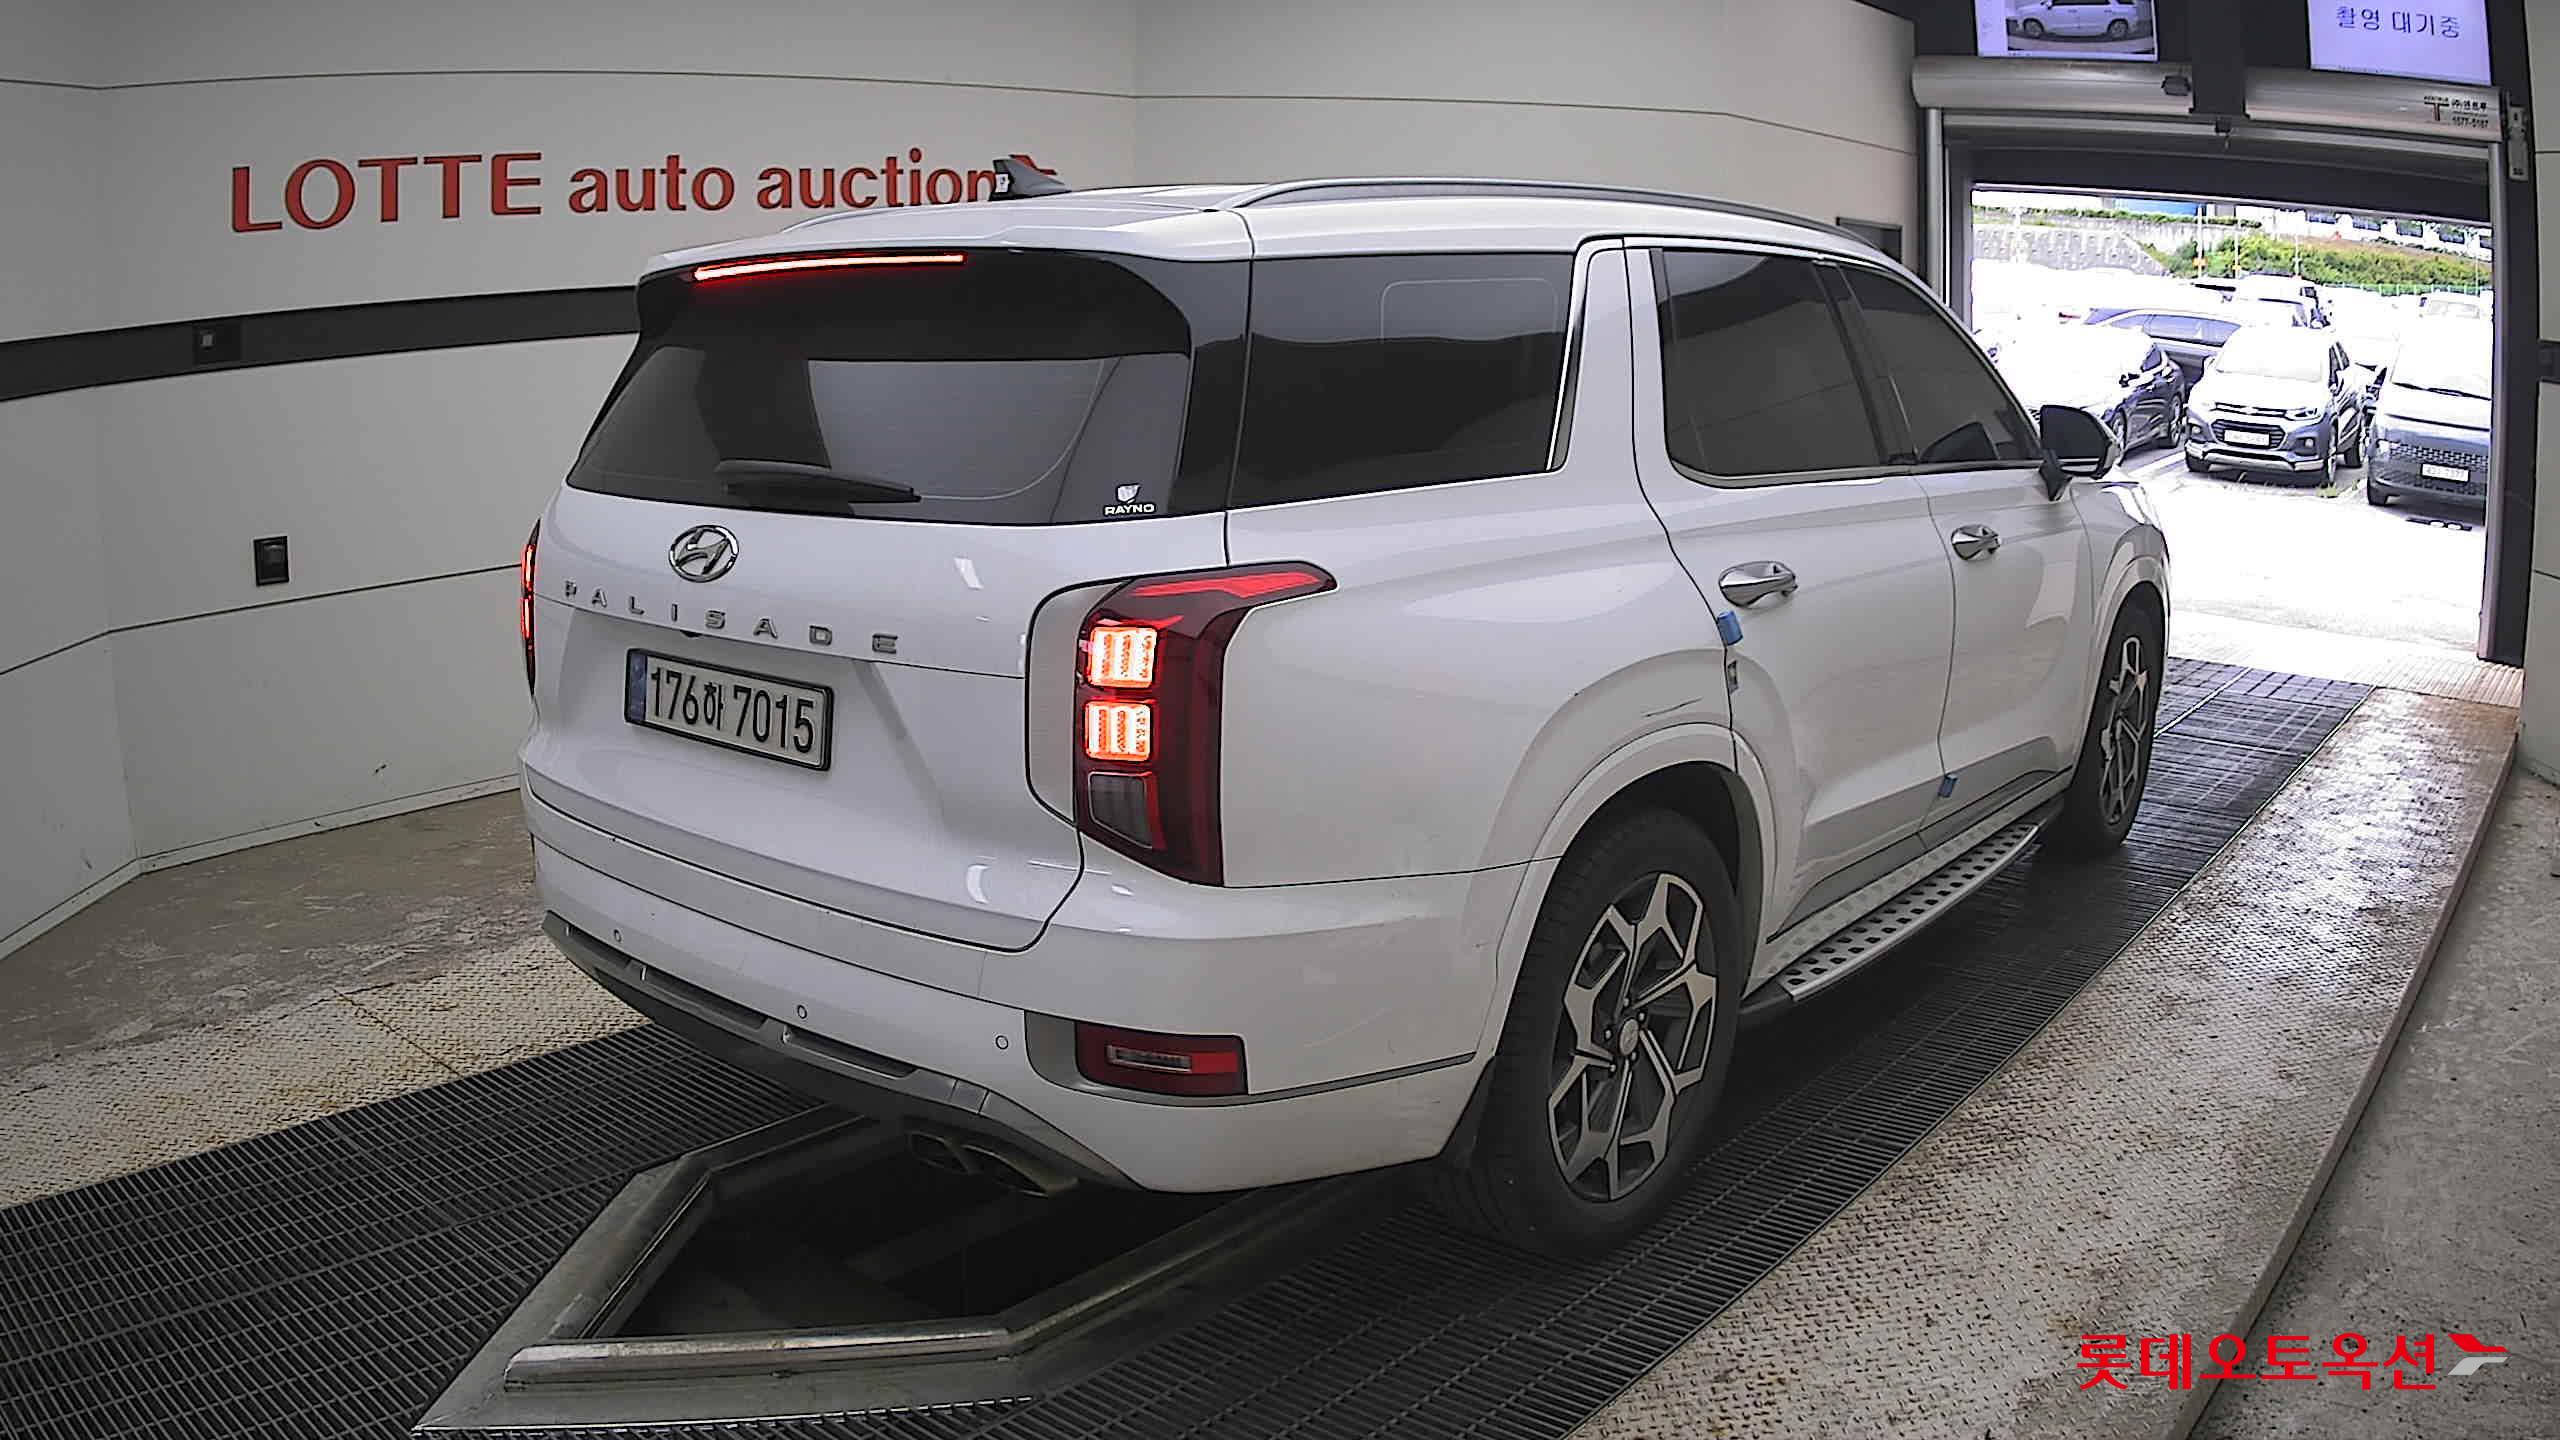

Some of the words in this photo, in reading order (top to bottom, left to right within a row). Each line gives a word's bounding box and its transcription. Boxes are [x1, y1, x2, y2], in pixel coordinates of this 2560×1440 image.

[2336, 6, 2381, 31] 촬영
[2392, 11, 2460, 38] 대기중
[231, 152, 542, 233] LOTTE
[569, 154, 736, 213] auto
[756, 147, 998, 209] auction
[1104, 503, 1155, 516] RAYNO
[564, 579, 899, 655] PALISADE
[651, 666, 725, 731] 176하
[732, 684, 815, 755] 7015
